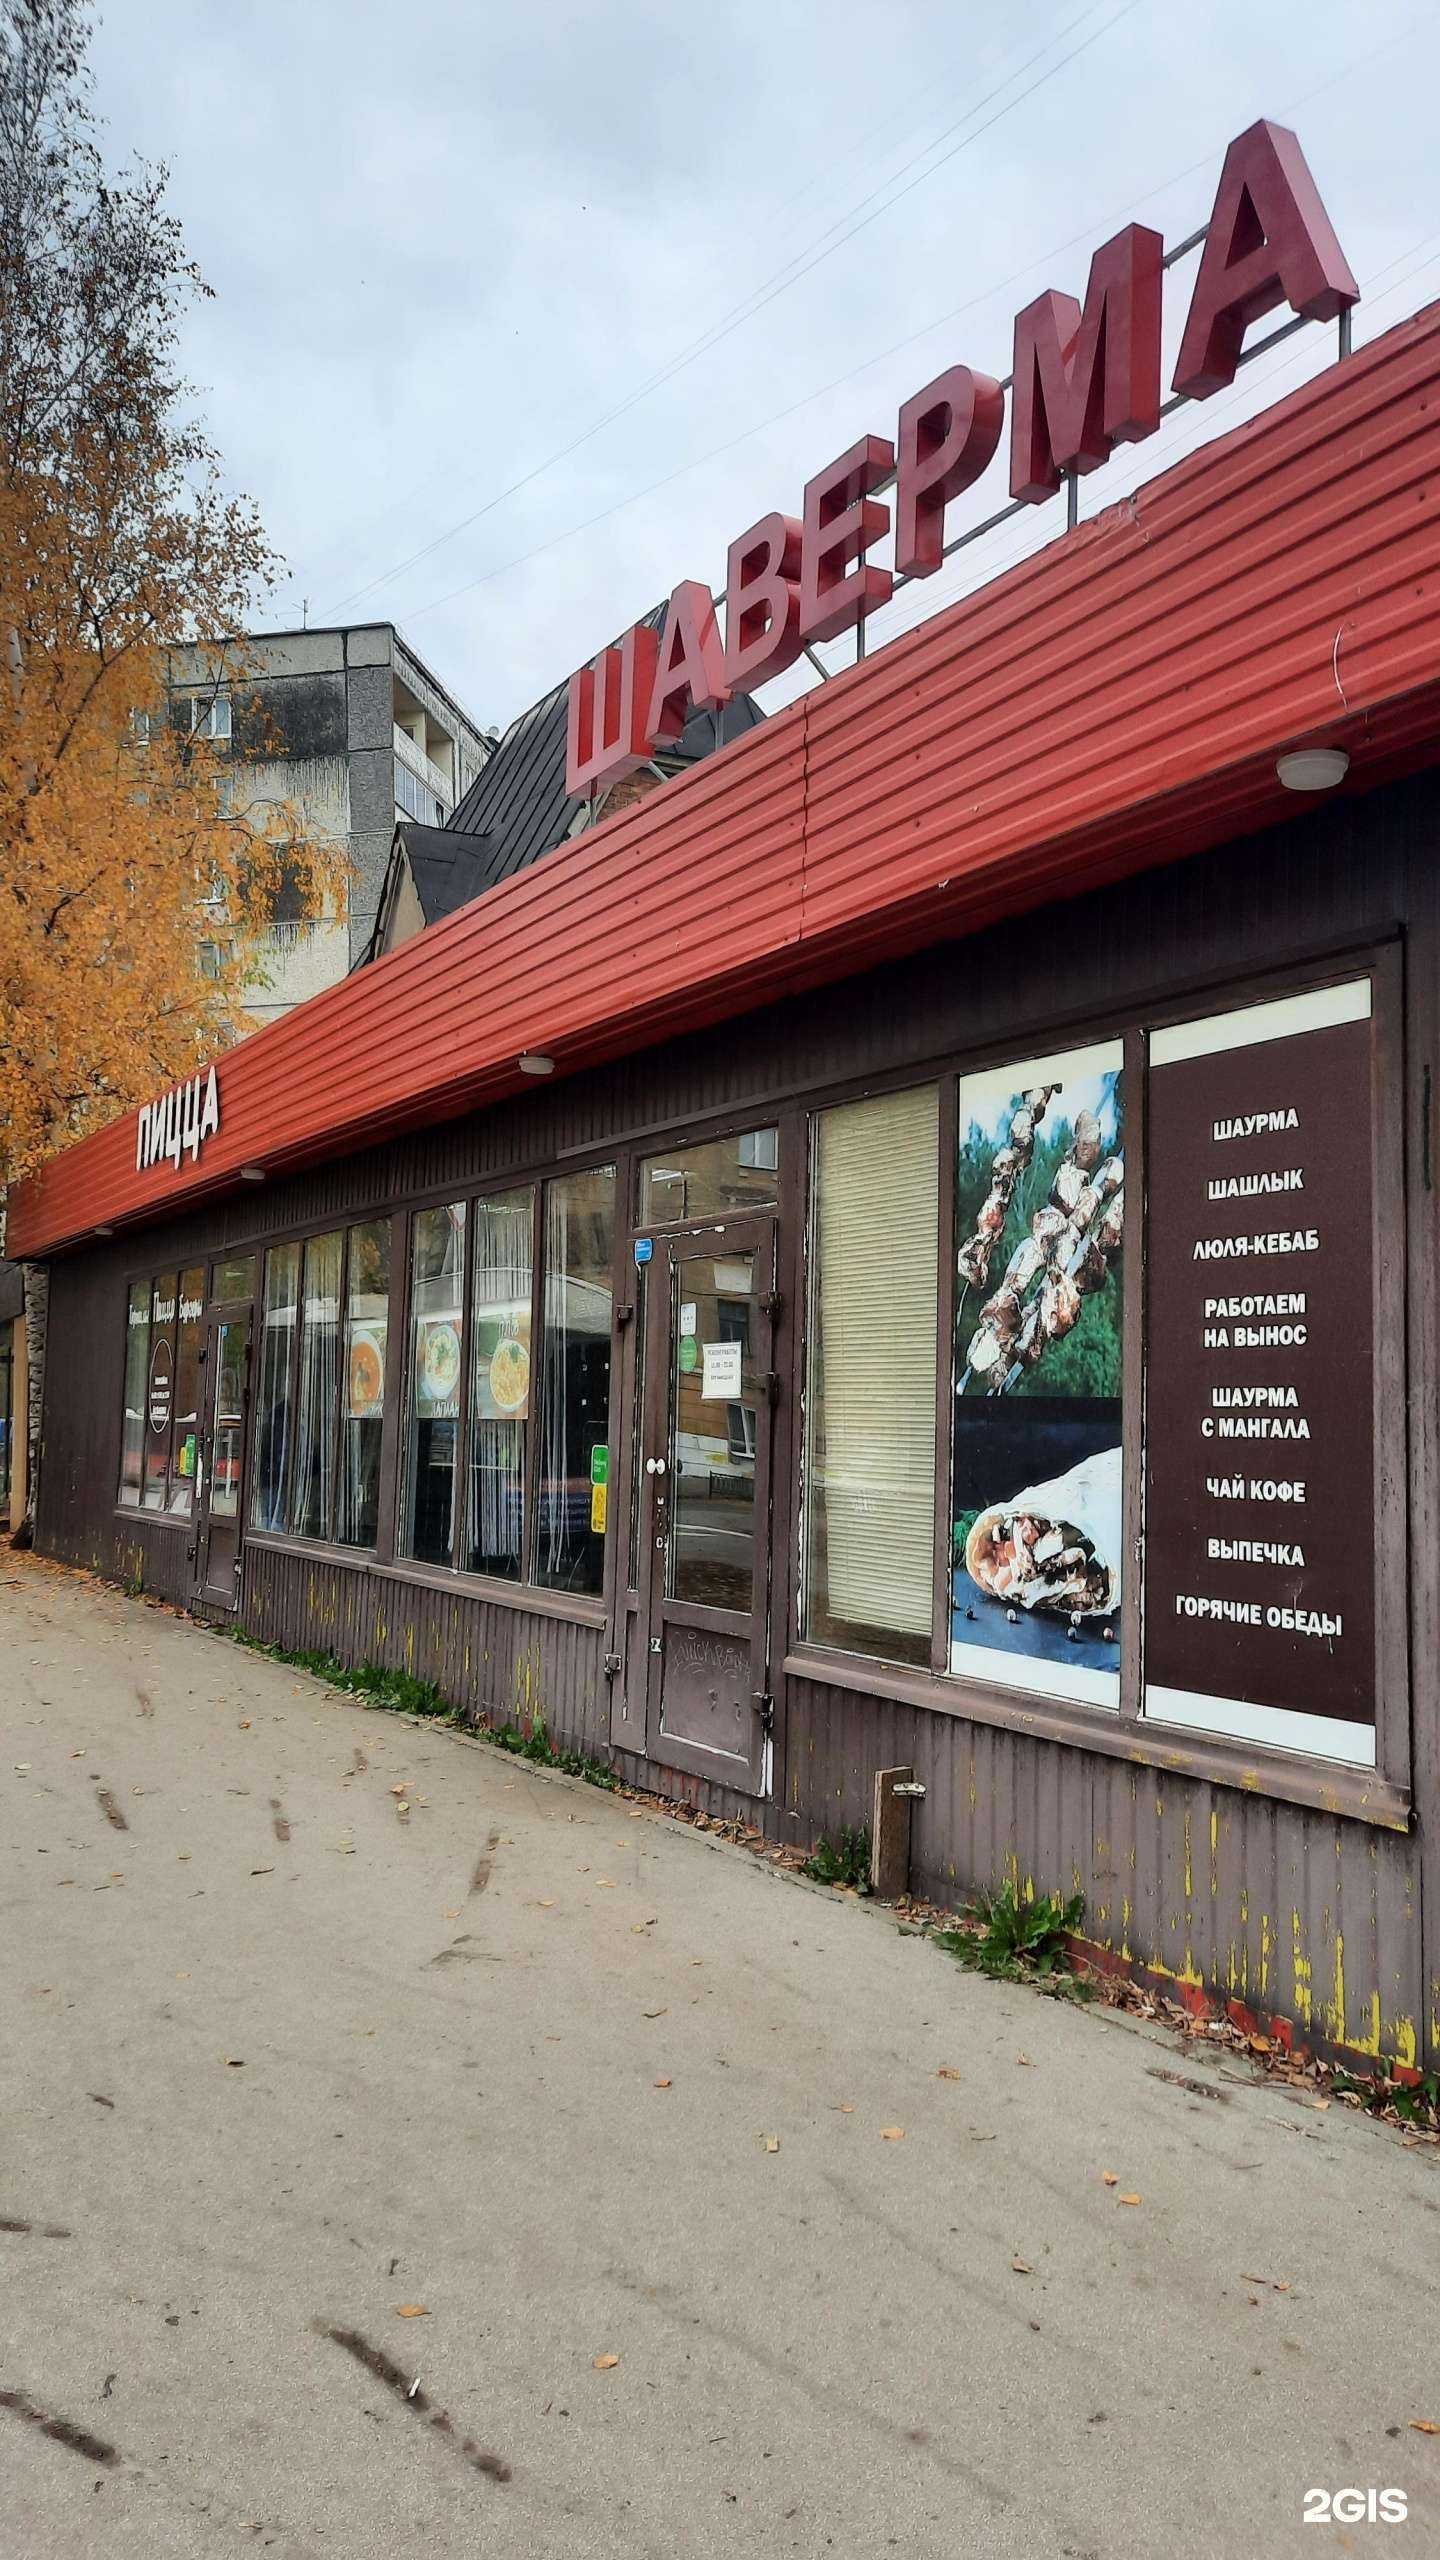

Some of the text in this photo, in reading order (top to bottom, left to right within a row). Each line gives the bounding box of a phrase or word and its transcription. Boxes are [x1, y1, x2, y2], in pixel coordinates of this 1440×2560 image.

[566, 118, 1359, 798] ШАВЕРМА
[136, 1065, 218, 1170] ПИЦЦА
[1213, 1108, 1299, 1141] ШАУРМА
[1208, 1168, 1304, 1200] ШАШЛЫК
[1192, 1229, 1319, 1260] ЛЮЛЯ-КЕБАБ
[1204, 1293, 1306, 1317] РАБОТАЕМ
[1204, 1325, 1307, 1347] НА ВЫНОС
[1212, 1387, 1298, 1408] ШАУРМА
[1201, 1418, 1310, 1439] С МАНГАЛА
[1206, 1473, 1306, 1502] ЧАЙ КОФЕ
[1207, 1538, 1305, 1566] ВЫПЕЧКА
[1176, 1595, 1342, 1637] ГОРЯЧИЕ ОБЕДЫ
